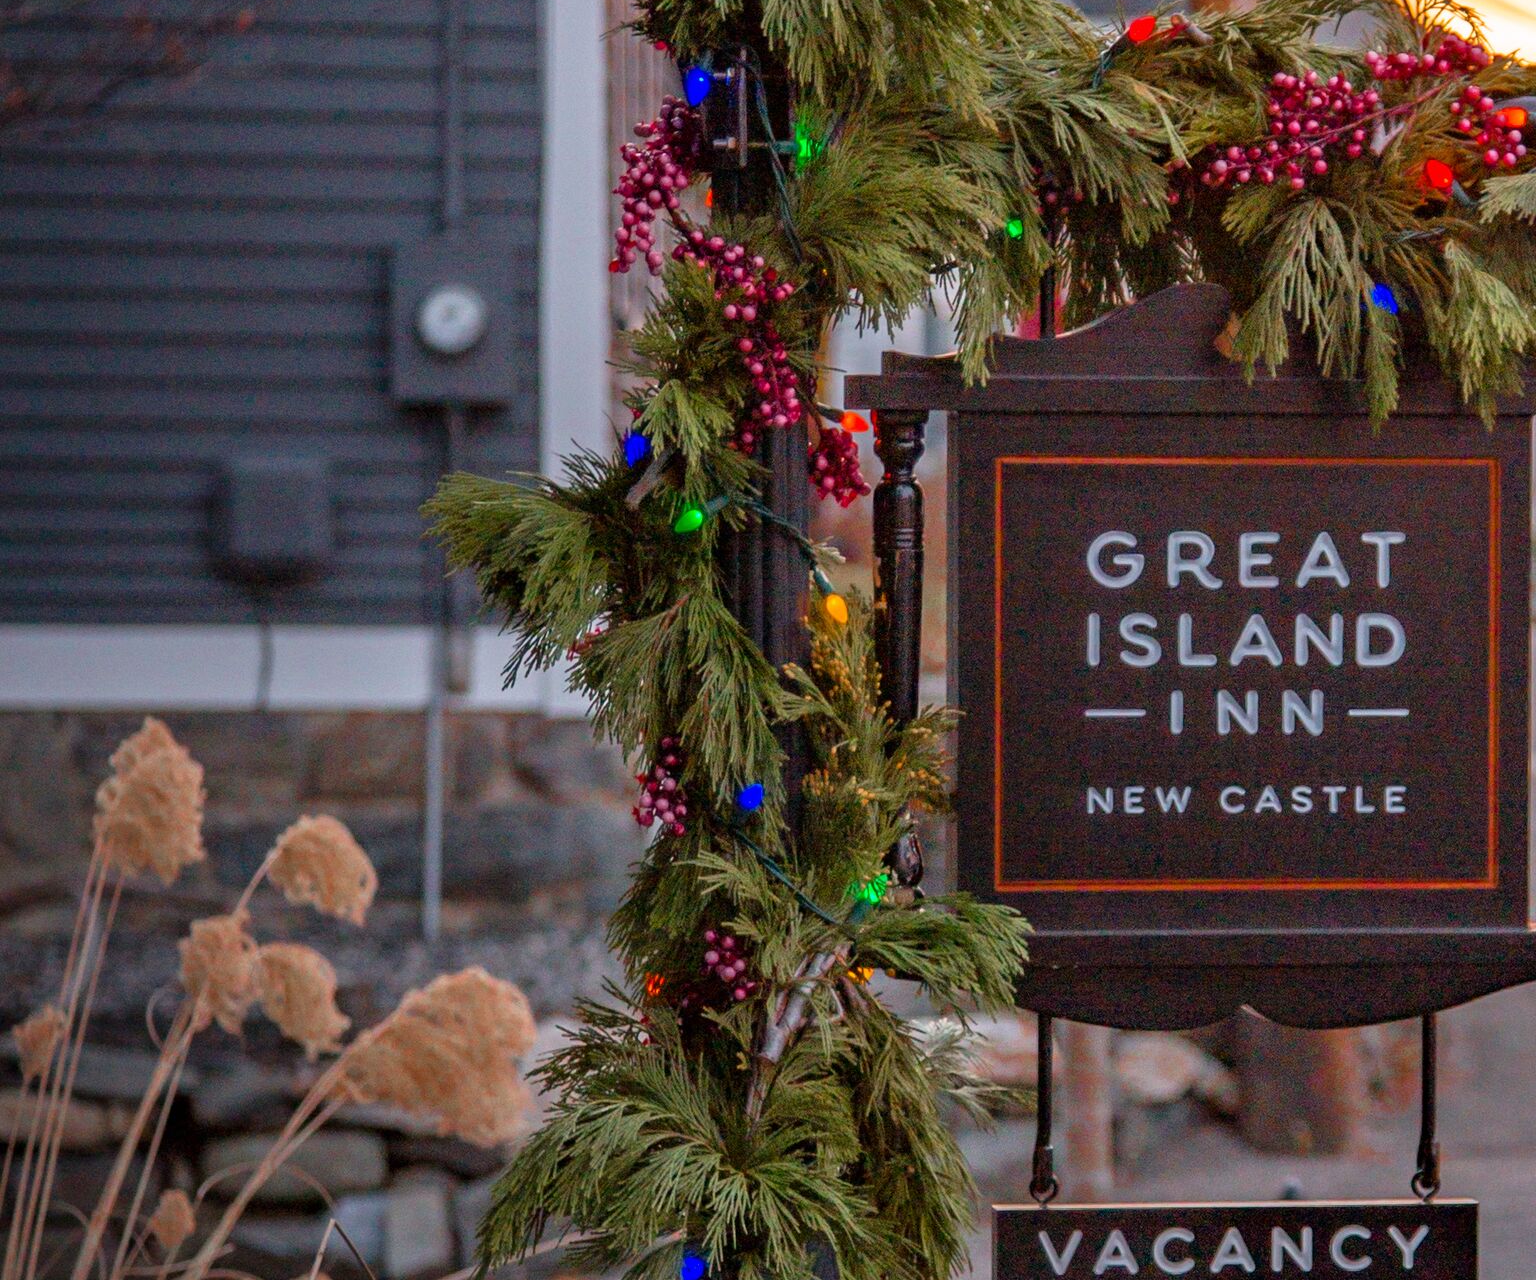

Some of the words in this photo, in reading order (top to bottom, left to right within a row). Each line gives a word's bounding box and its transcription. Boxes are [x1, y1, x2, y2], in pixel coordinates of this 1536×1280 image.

[1086, 530, 1406, 590] GREAT
[1086, 612, 1406, 668] ISLAND
[1086, 786, 1192, 815] NEW
[1219, 785, 1407, 814] CASTLE
[1038, 1225, 1428, 1276] VACANCY
